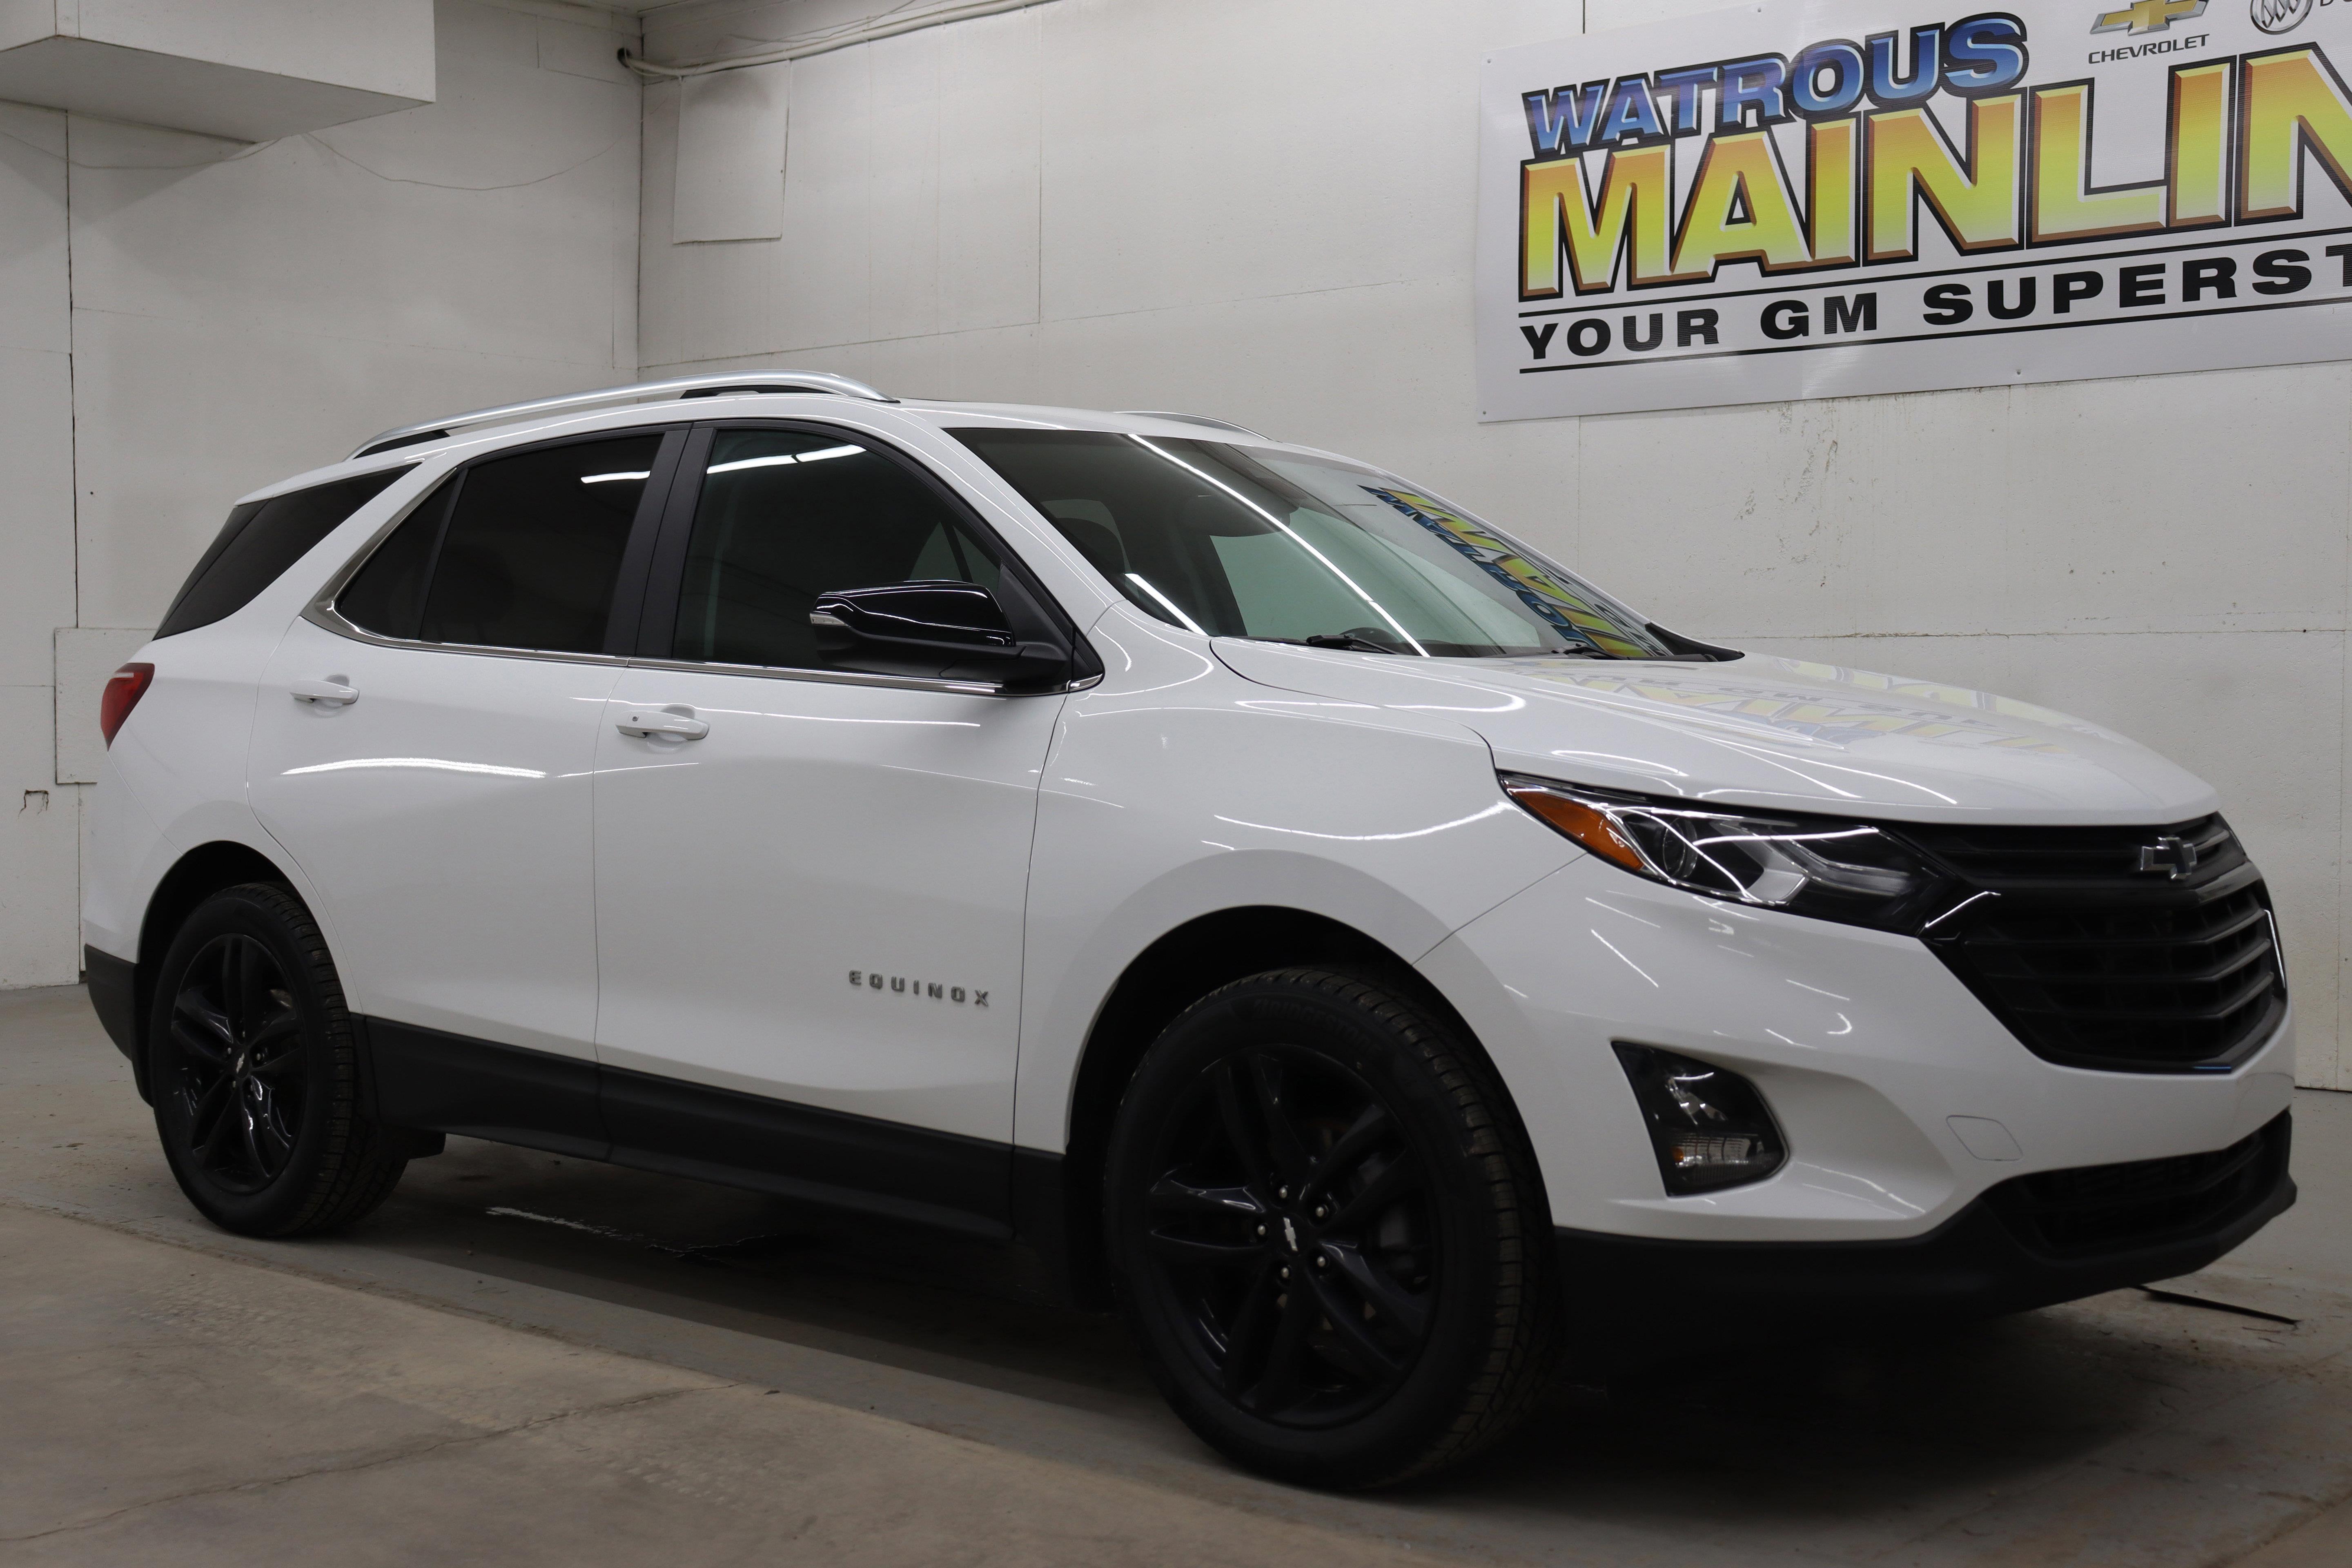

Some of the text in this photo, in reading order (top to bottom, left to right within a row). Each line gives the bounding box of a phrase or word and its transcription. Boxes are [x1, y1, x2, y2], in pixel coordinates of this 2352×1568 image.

[2089, 34, 2209, 64] CHEVROLET
[1522, 12, 2028, 158] WATROUS
[1519, 309, 1719, 360] YOUR
[1760, 292, 1877, 340] GM
[849, 969, 989, 1007] EQUINOX
